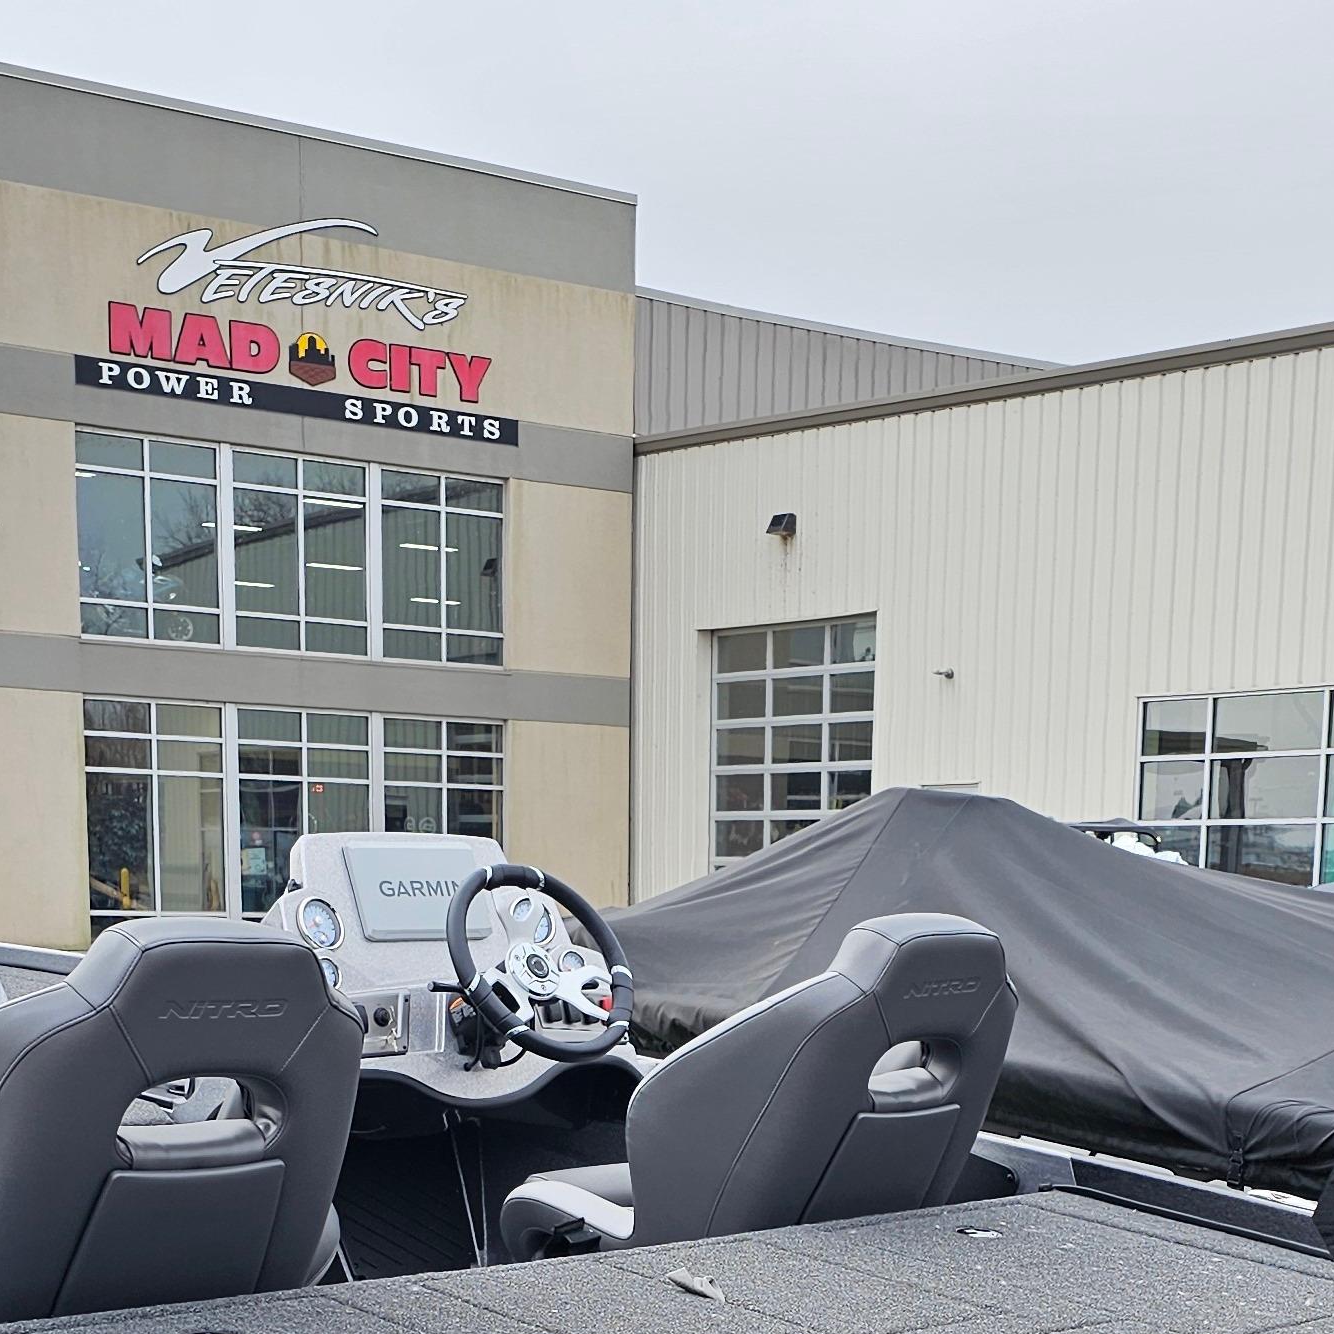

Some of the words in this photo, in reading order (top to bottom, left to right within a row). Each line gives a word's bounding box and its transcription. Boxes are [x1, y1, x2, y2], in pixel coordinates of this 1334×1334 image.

[137, 217, 468, 331] VETESNIK'S
[108, 301, 280, 374] MAD
[348, 339, 491, 403] CITY
[98, 362, 254, 405] POWER
[344, 398, 501, 440] SPORTS
[159, 1000, 288, 1020] NITRO
[903, 976, 982, 999] NITRO
